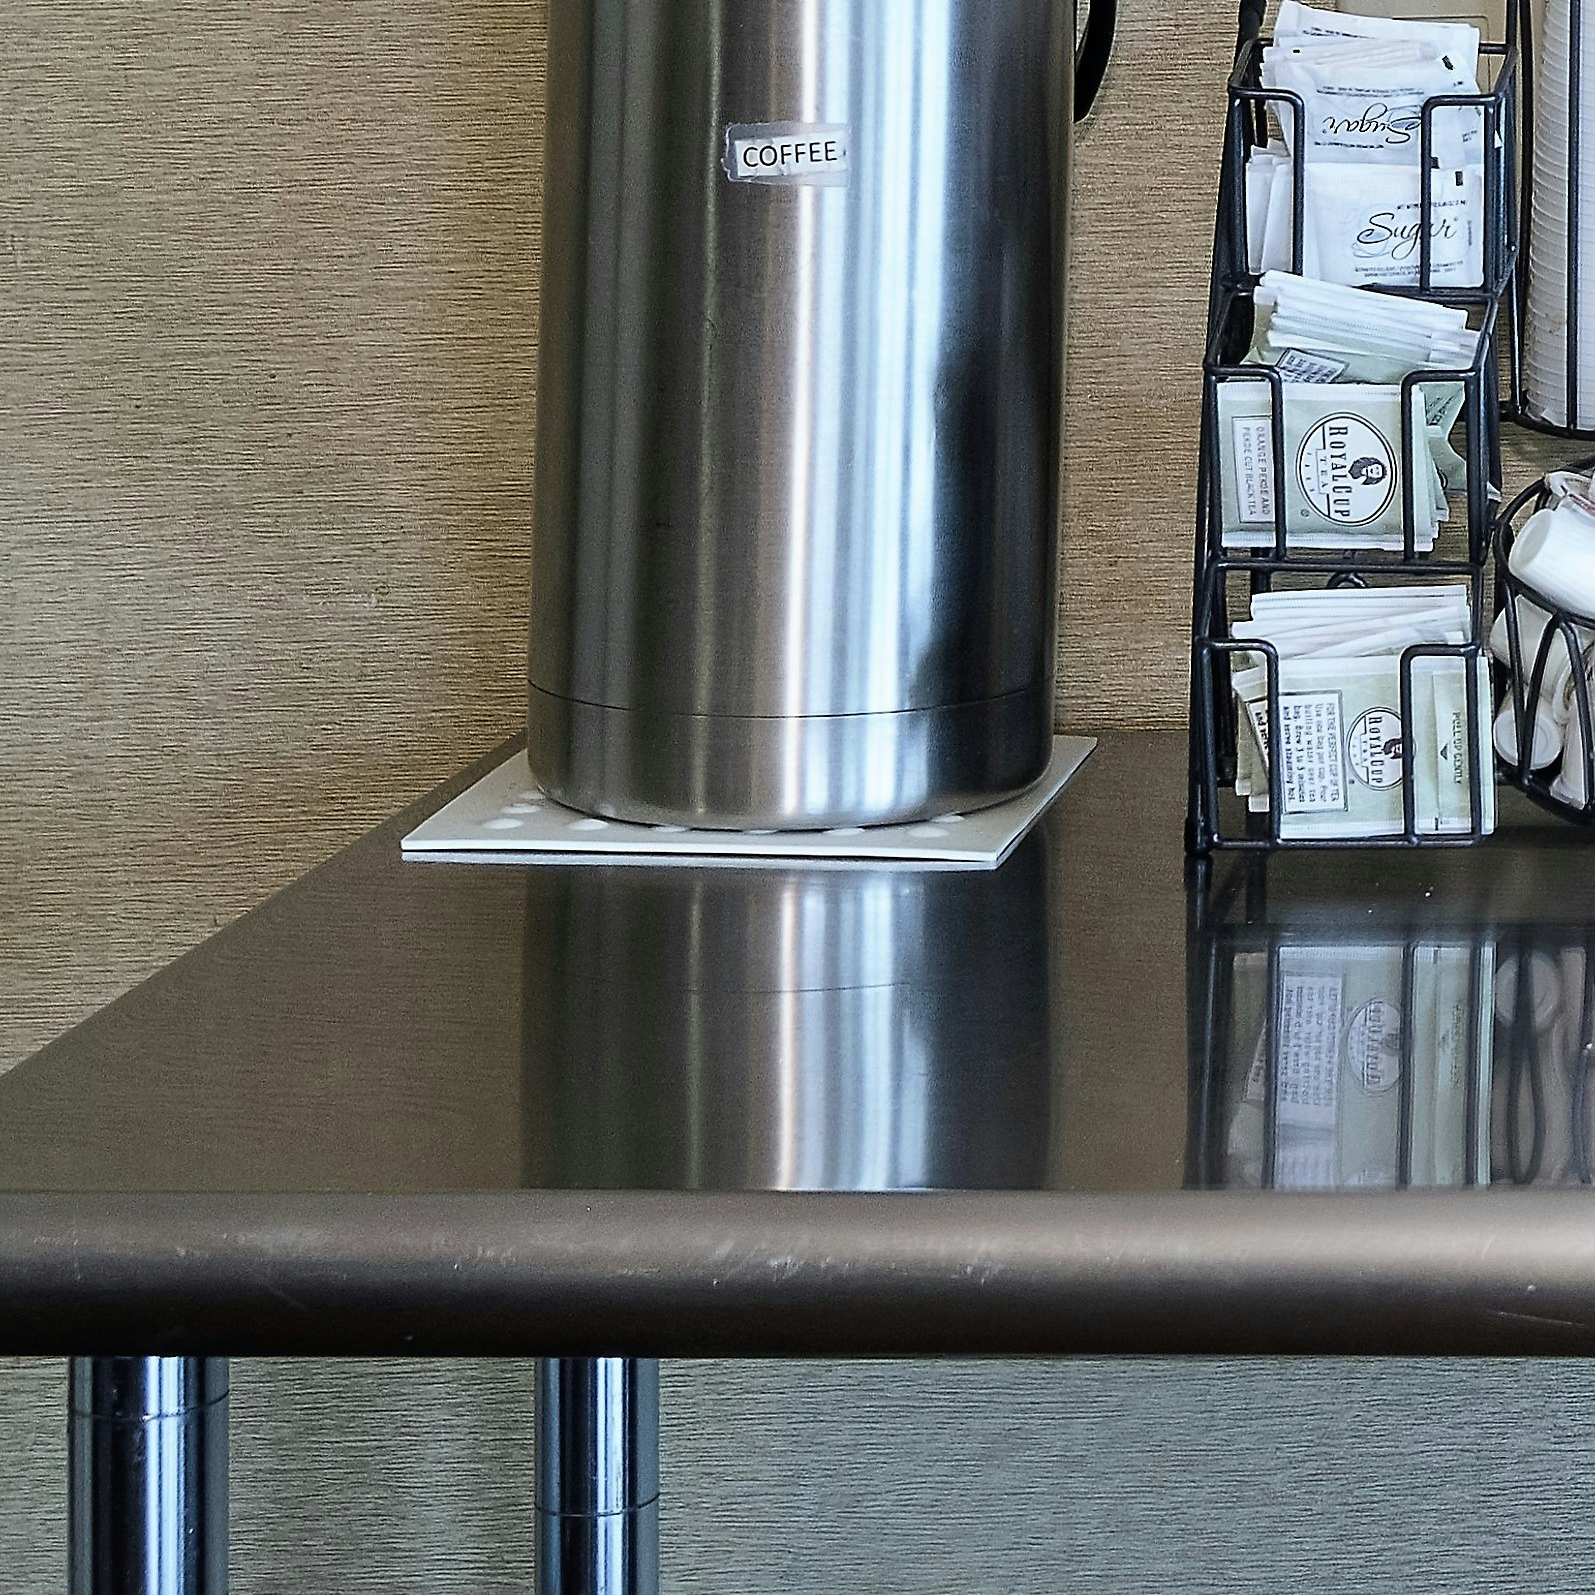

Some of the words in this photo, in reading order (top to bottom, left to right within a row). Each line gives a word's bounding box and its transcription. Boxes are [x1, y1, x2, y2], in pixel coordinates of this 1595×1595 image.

[1322, 102, 1421, 144] Sugar
[743, 141, 837, 168] COFFEE
[1356, 212, 1458, 261] Sugr
